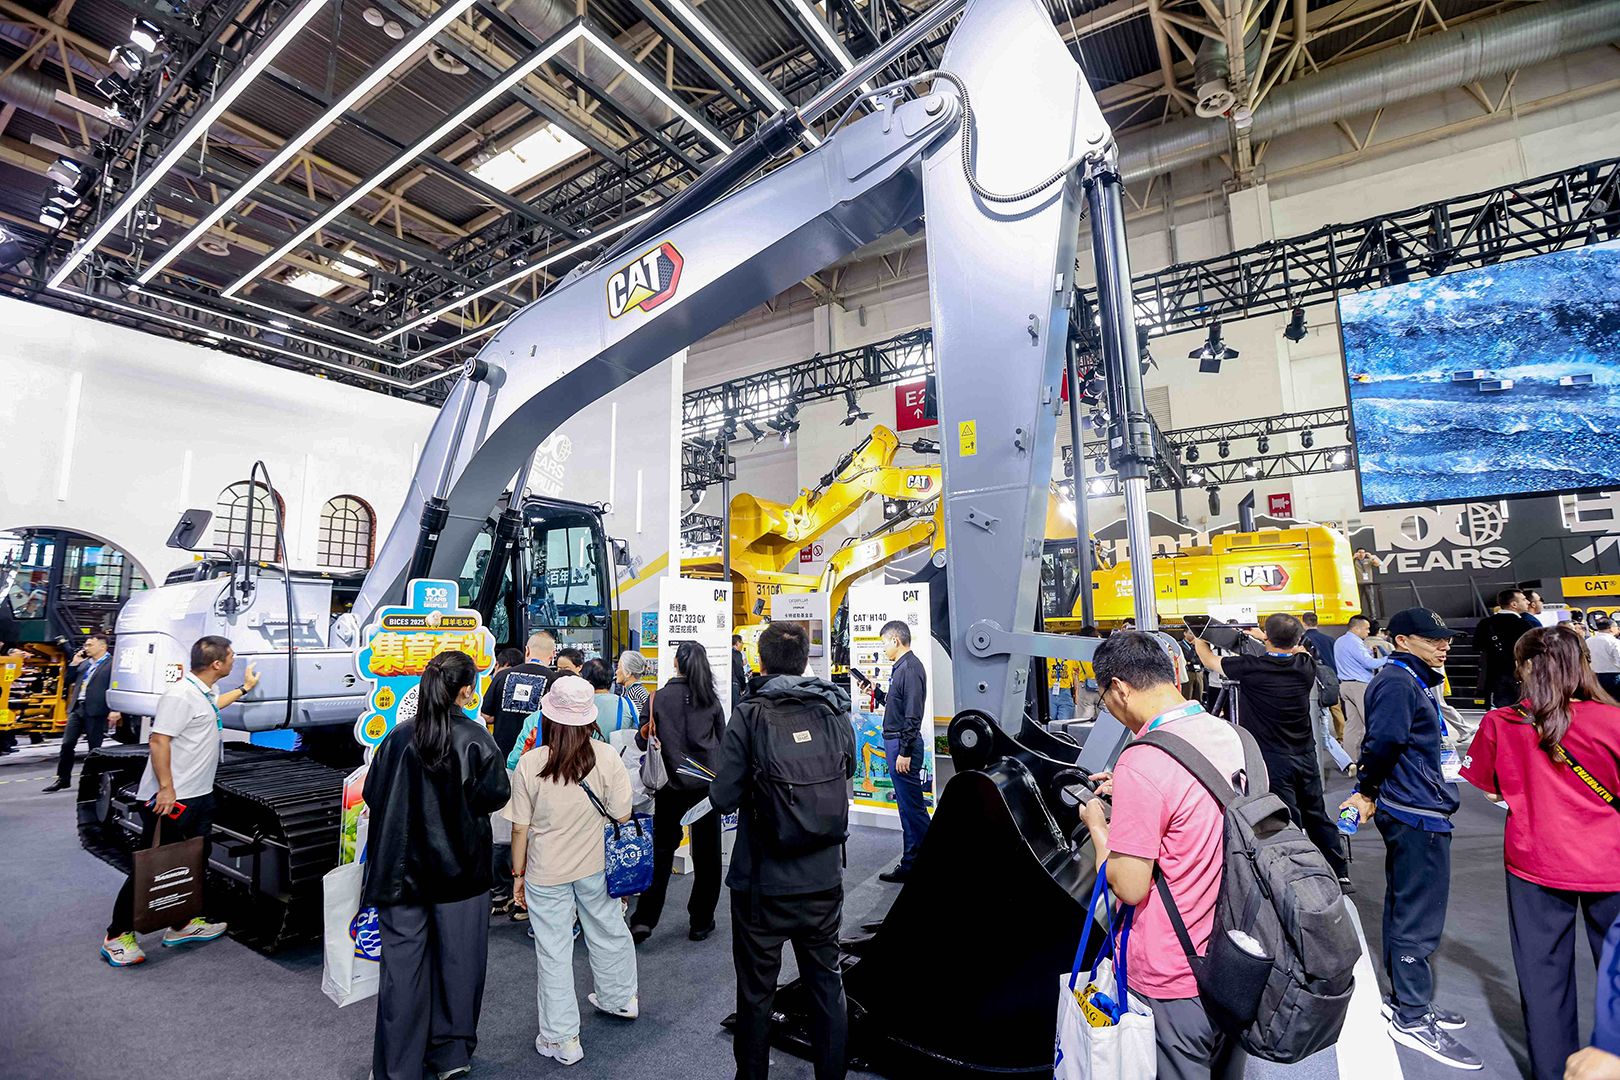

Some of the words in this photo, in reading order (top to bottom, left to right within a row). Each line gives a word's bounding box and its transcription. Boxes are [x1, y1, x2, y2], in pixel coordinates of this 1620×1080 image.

[608, 247, 662, 318] CAT
[533, 449, 565, 480] EARS
[907, 475, 928, 488] CAT
[1378, 547, 1512, 574] YEARS
[1240, 565, 1276, 587] CAT
[714, 589, 728, 601] CAT
[903, 591, 919, 601] CAT
[685, 614, 696, 624] 323
[697, 615, 706, 624] GX
[870, 613, 887, 622] H140
[610, 849, 649, 861] CHAGEE
